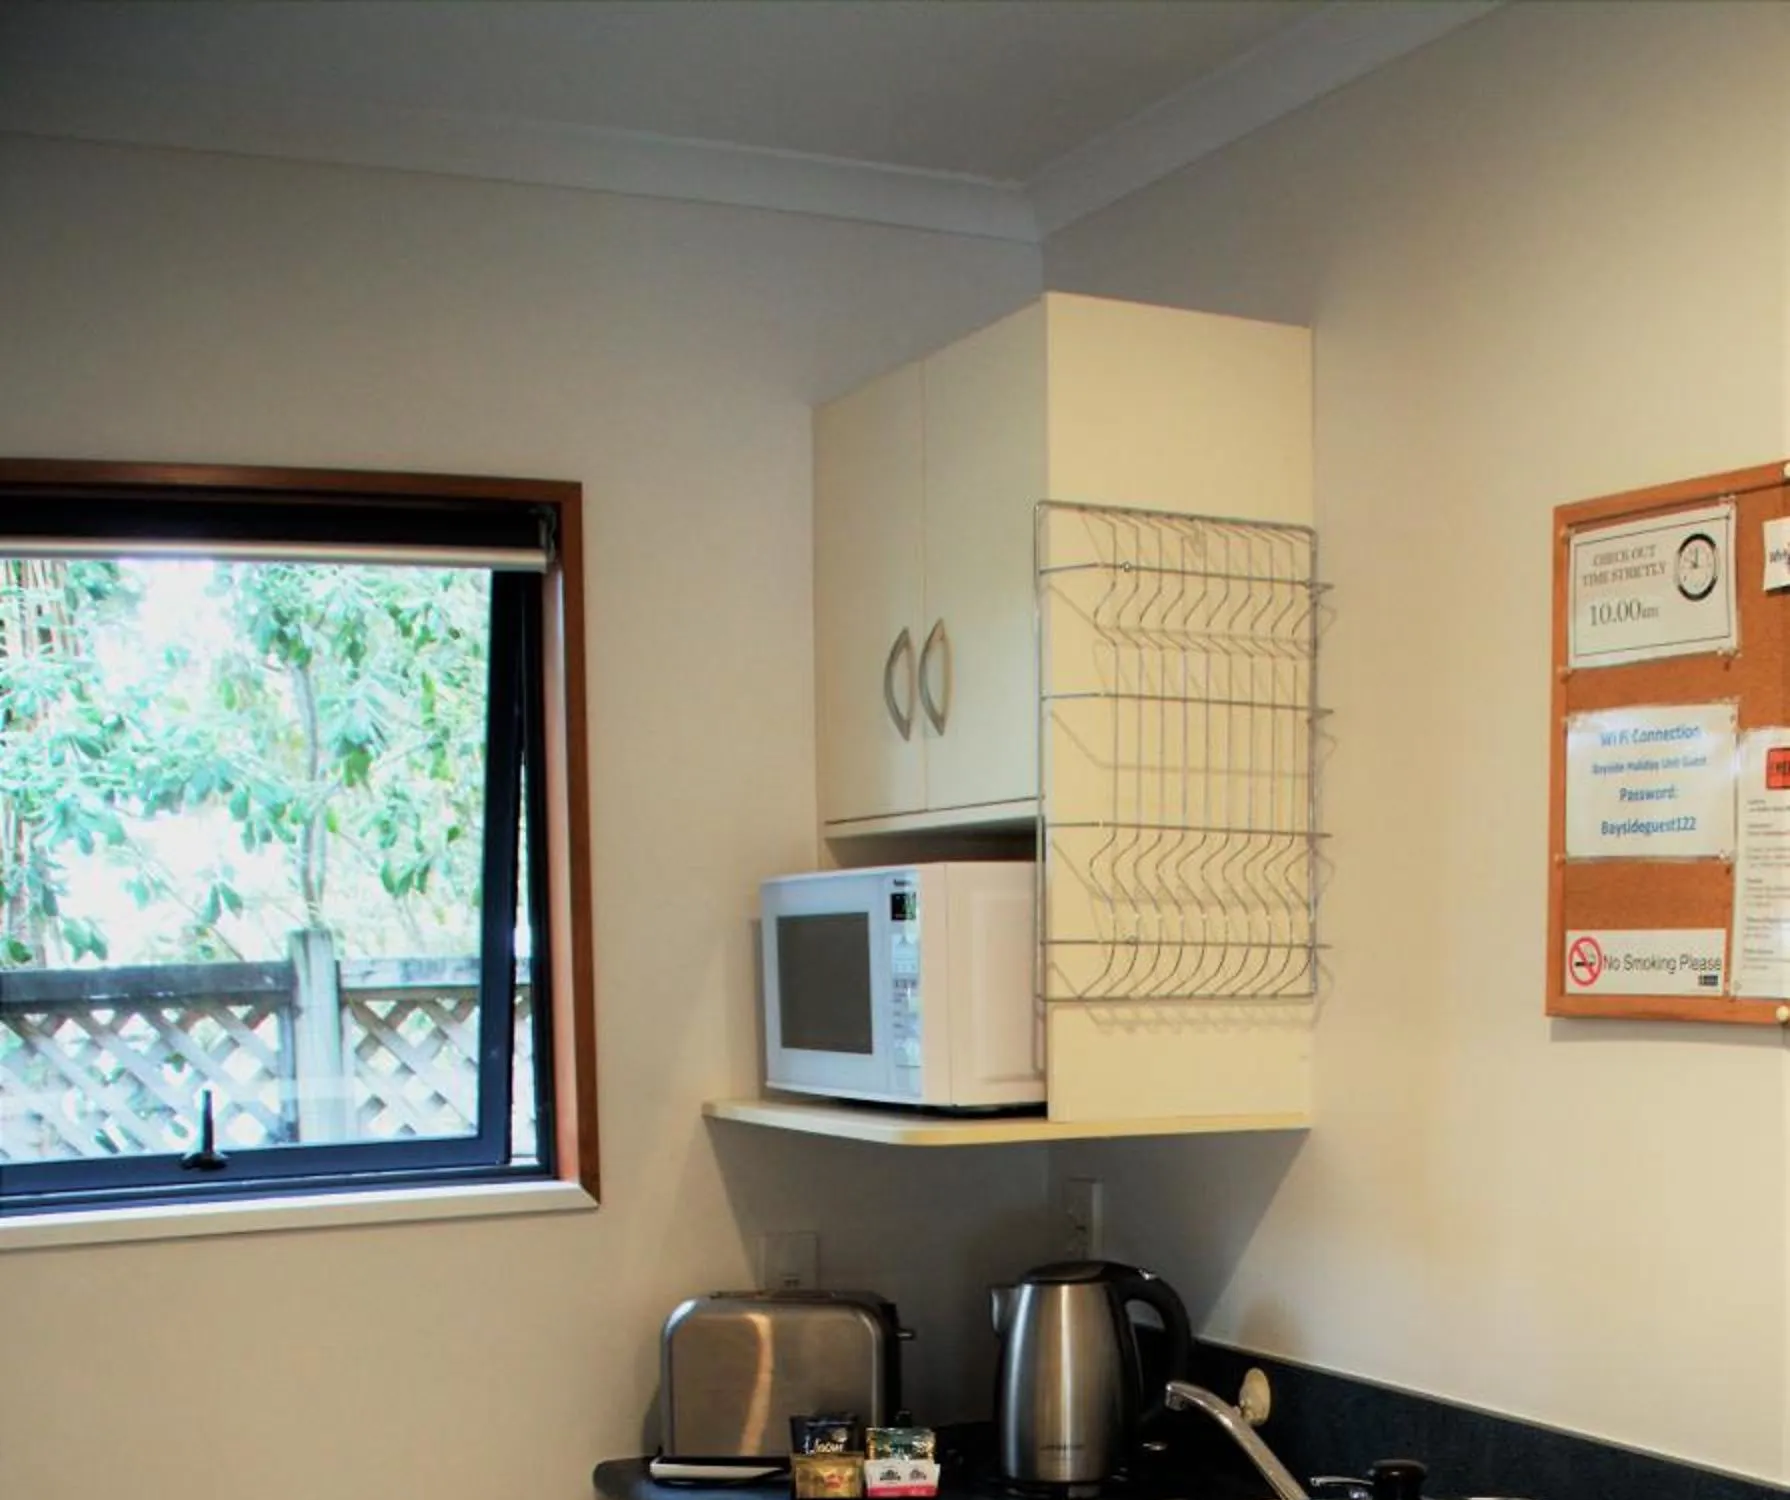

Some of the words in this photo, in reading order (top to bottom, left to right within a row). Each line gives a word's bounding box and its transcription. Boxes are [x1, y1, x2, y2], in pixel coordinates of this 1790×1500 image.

[1632, 724, 1699, 744] Connection
[1603, 955, 1621, 971] No
[1623, 953, 1677, 975] Smoking
[1679, 952, 1722, 971] Please
